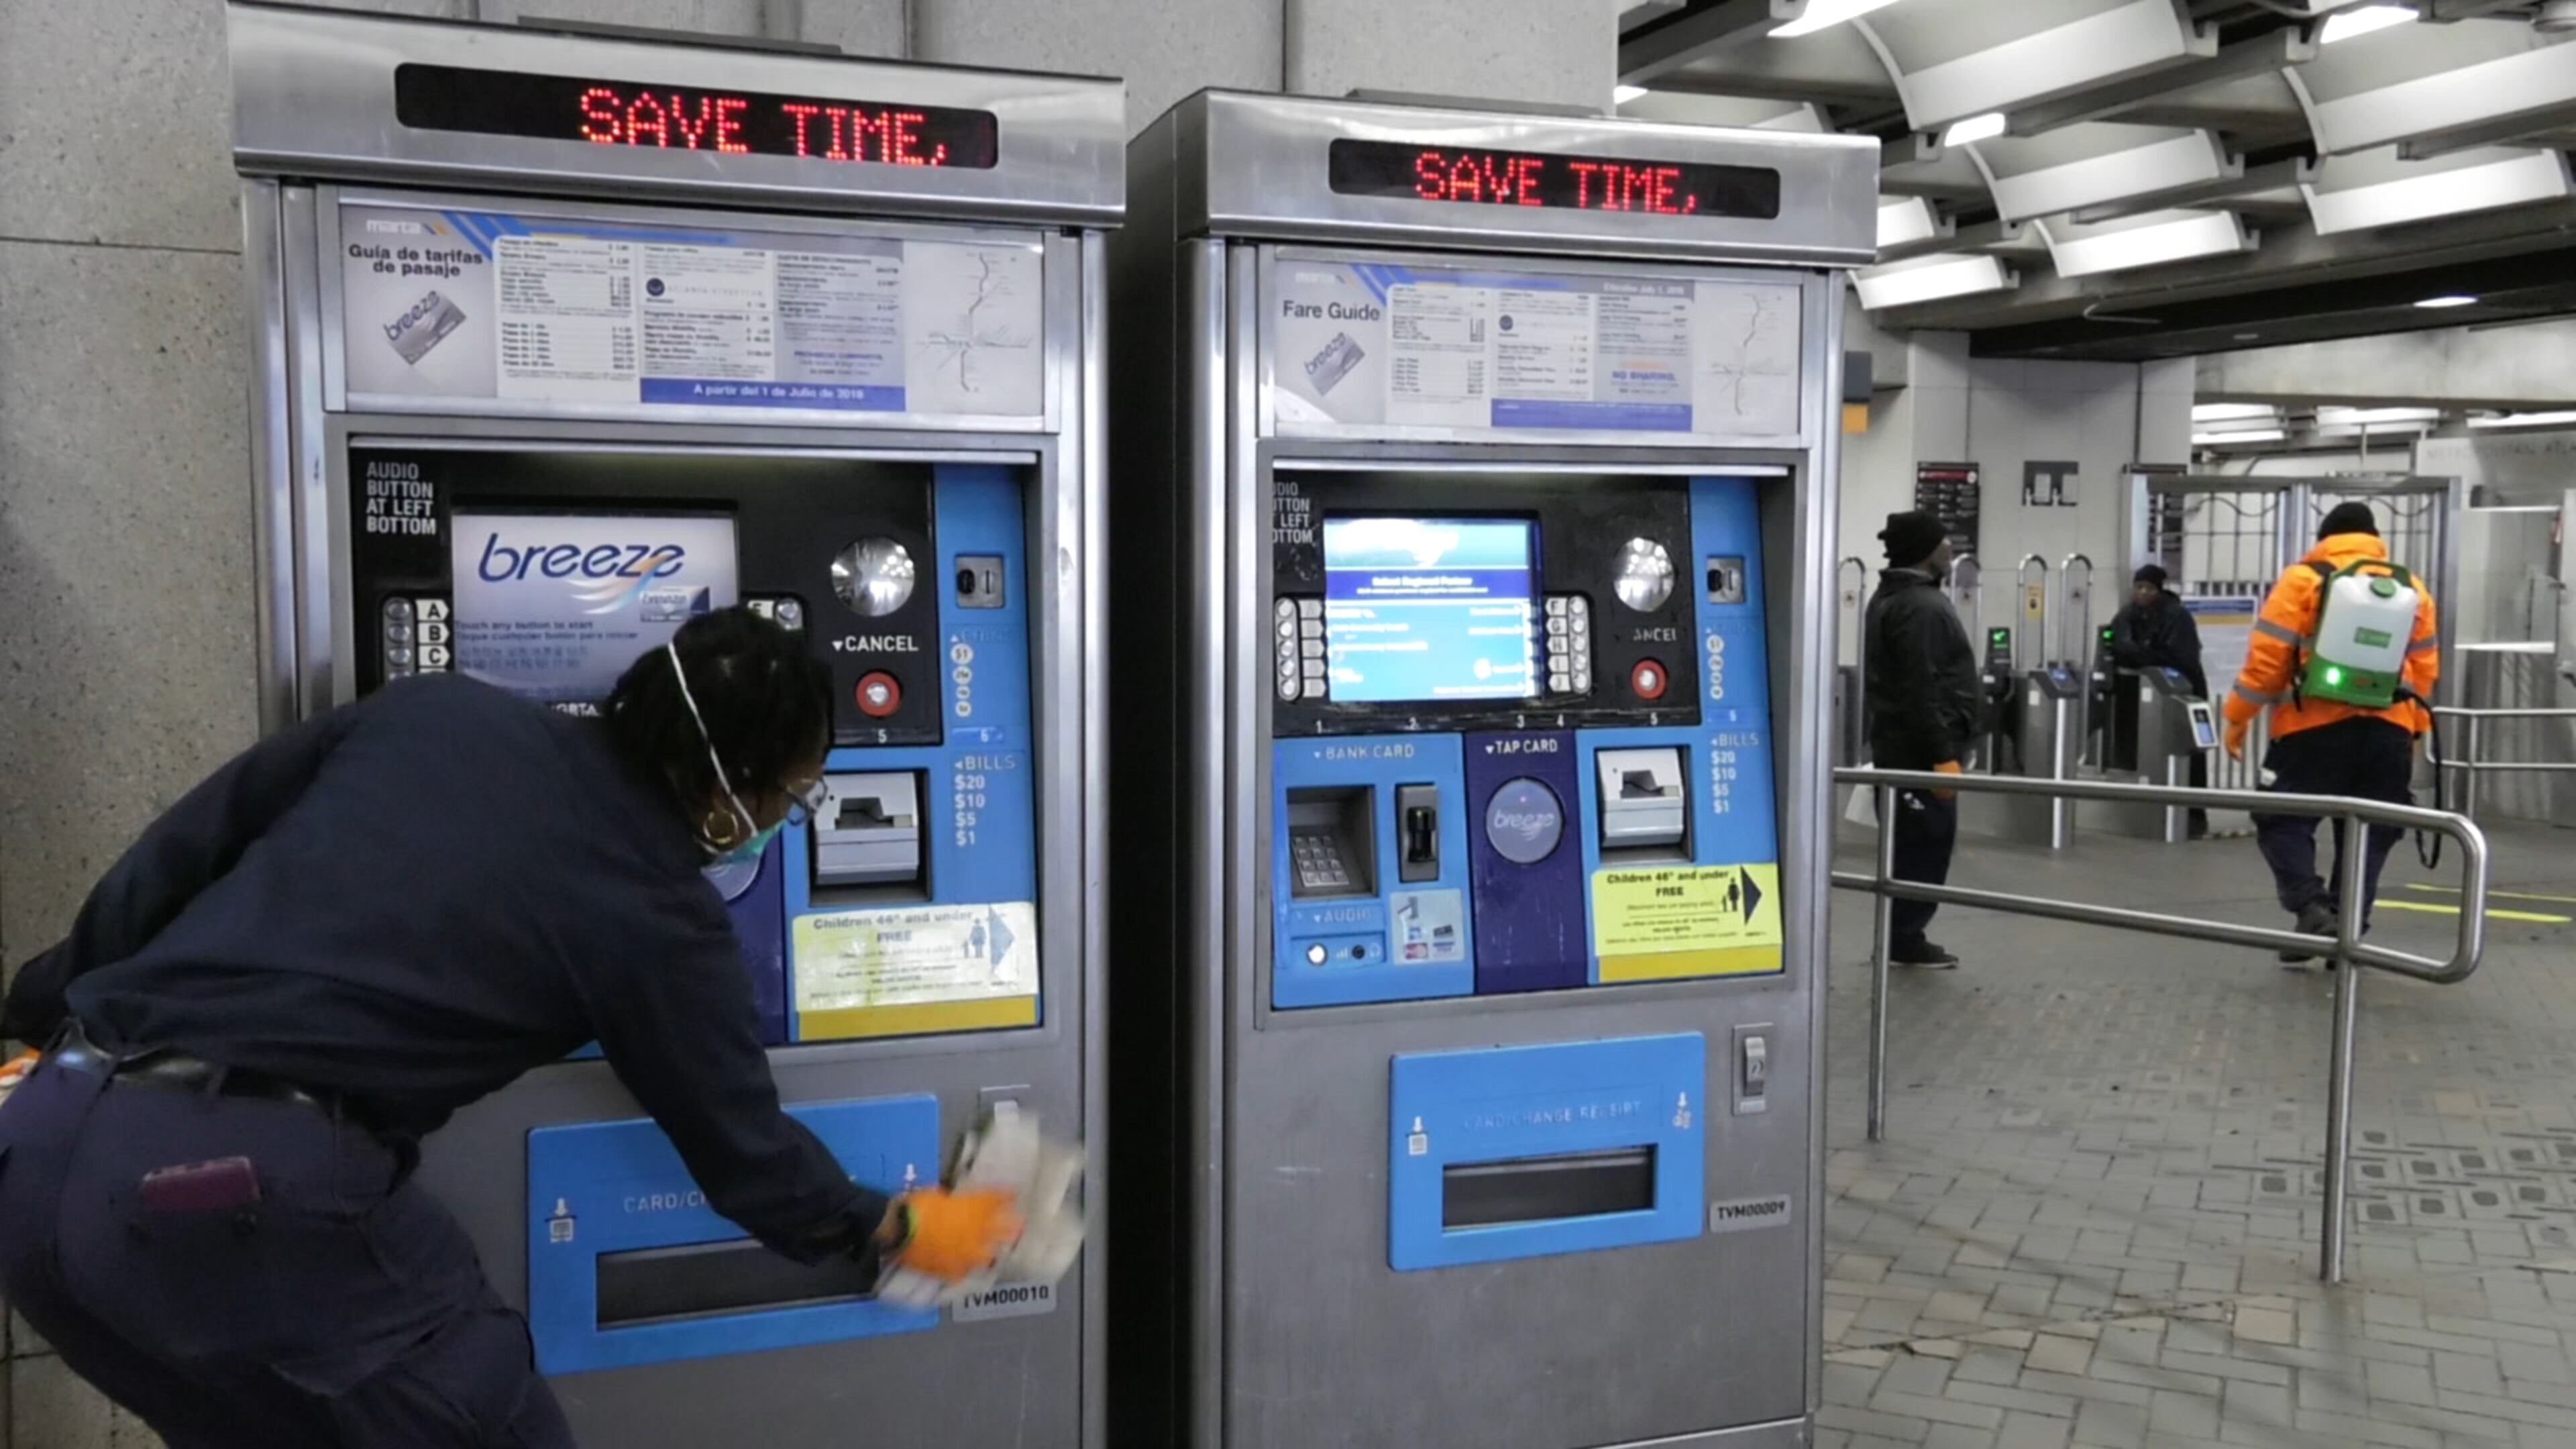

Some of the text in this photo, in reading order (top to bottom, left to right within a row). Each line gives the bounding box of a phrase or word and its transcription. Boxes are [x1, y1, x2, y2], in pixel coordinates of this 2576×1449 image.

[581, 88, 946, 166] SAVE TIME,
[1415, 152, 1696, 215] SAVE TIME,
[349, 244, 483, 264] Guía de tarifas
[373, 260, 461, 278] de pasaje
[383, 290, 440, 341] breeze
[1283, 300, 1381, 321] Fare Guide
[706, 384, 737, 397] partir
[741, 385, 759, 396] del
[771, 386, 787, 397] de
[819, 388, 834, 399] de
[367, 462, 419, 480] AUDIO
[367, 480, 433, 498] BUTTON
[366, 498, 434, 517] AT LEFT
[367, 515, 436, 535] BOTTOM
[1281, 513, 1309, 528] LEFT
[478, 533, 685, 583] breeze
[427, 603, 441, 619] A
[1551, 600, 1558, 614] F
[429, 626, 441, 641] B
[492, 621, 511, 631] any
[515, 621, 551, 630] button
[554, 621, 565, 630] to
[568, 621, 593, 630] start
[1552, 619, 1560, 633] G
[845, 635, 918, 652] CANCEL
[1552, 639, 1562, 651] H
[429, 649, 441, 664] C
[1316, 719, 1322, 733] 1
[1409, 716, 1417, 730] 2
[1517, 714, 1525, 729] 3
[1556, 714, 1564, 728] 4
[1650, 713, 1658, 724] 5
[878, 729, 887, 743] 5
[980, 728, 989, 743] 6
[1719, 733, 1760, 747] BILLS
[1326, 744, 1415, 761] BANK CARD
[1495, 739, 1558, 754] TAP CARD
[965, 755, 1016, 770] BILLS
[1711, 750, 1736, 765] $20
[1711, 767, 1737, 782] $10
[955, 774, 986, 791] $20
[1712, 782, 1729, 798] $5
[955, 793, 986, 810] $10
[1713, 799, 1729, 814] $1
[955, 811, 977, 828] $5
[1493, 810, 1555, 828] breeze
[956, 830, 975, 847] $1
[1607, 873, 1652, 884] Children
[1678, 871, 1697, 881] and
[1699, 870, 1730, 880] under
[1656, 886, 1684, 897] FREE
[813, 916, 871, 930] Children
[905, 912, 930, 924] and
[934, 910, 974, 922] under
[1324, 908, 1371, 923] AUDIO
[876, 929, 912, 943] FREE
[1718, 1201, 1785, 1220] TVM00009
